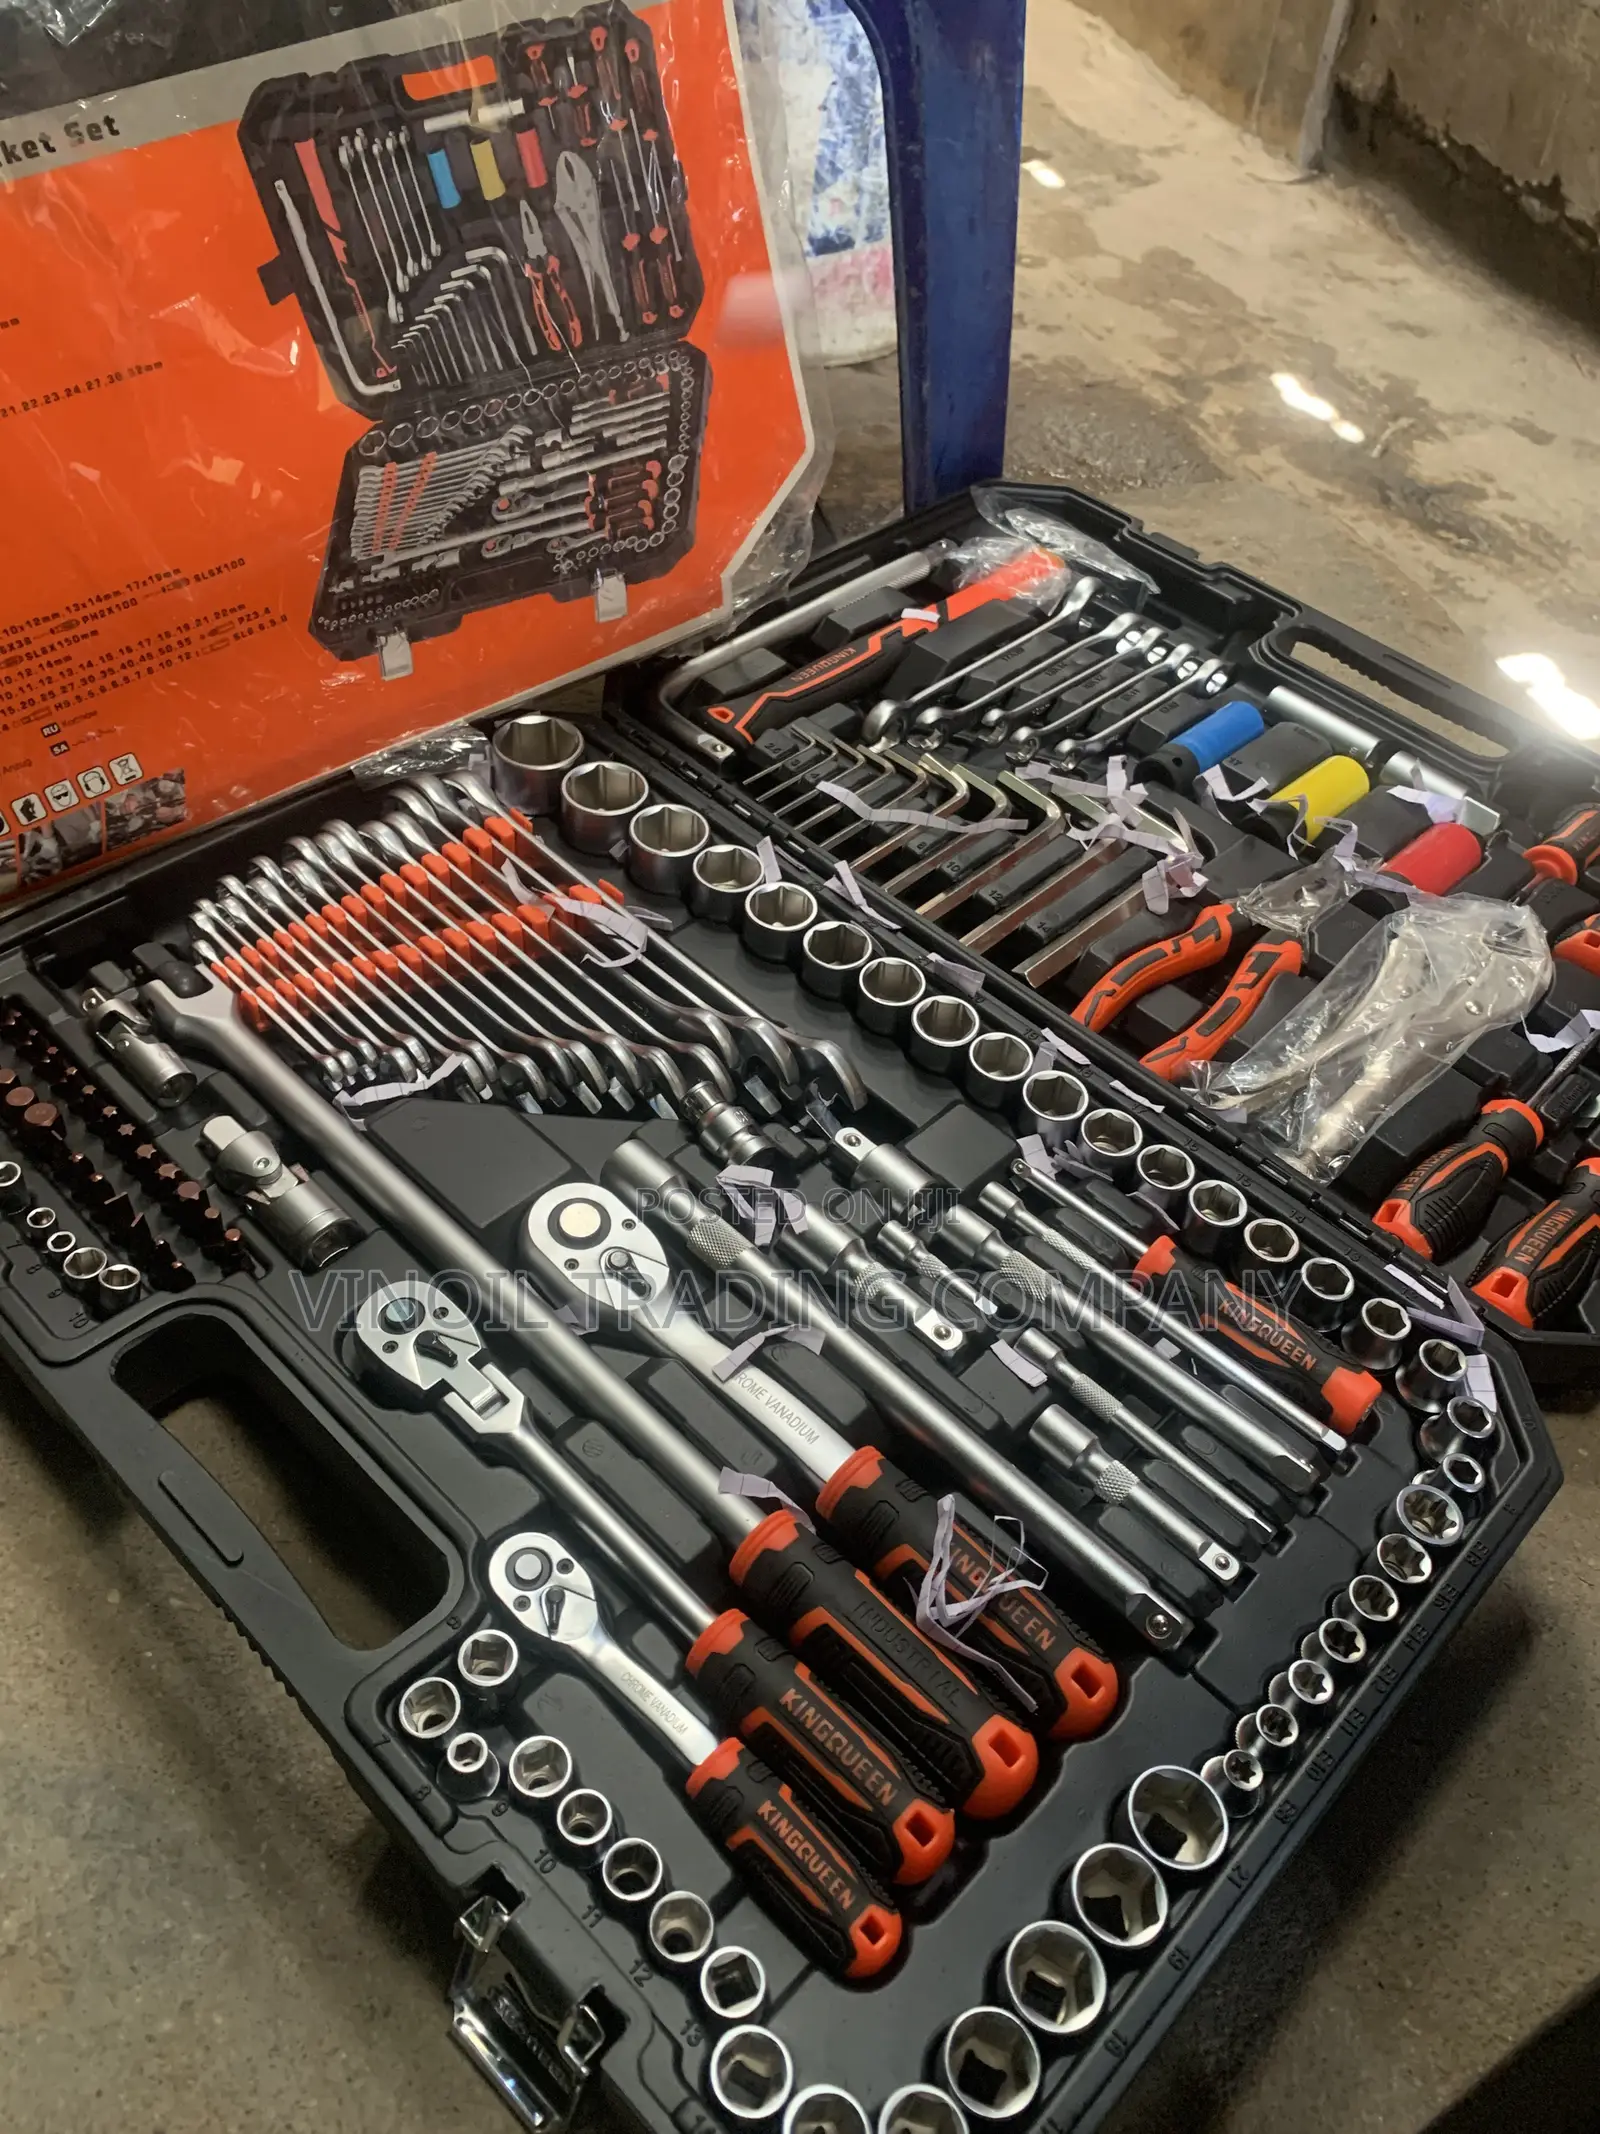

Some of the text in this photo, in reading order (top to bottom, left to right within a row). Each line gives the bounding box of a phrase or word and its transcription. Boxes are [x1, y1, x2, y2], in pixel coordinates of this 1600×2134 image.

[0, 115, 120, 168] ket Set
[791, 647, 857, 682] KINGQUEEN
[946, 861, 961, 873] 10
[988, 889, 1003, 901] 12
[1236, 1172, 1252, 1187] 15
[1514, 1206, 1578, 1266] KINGQUEEN
[69, 1311, 89, 1329] 10
[1219, 1300, 1318, 1371] KINGQUEEN
[736, 1371, 820, 1445] ROME VANADIUM
[950, 1543, 1056, 1651] INGUEEN
[852, 1600, 960, 1708] INDUSTRIAL
[1371, 1664, 1399, 1694] E12
[621, 1671, 689, 1736] CHROME VANADIUM
[1340, 1708, 1367, 1737] E11
[779, 1687, 898, 1806] KINGQUEEN
[1305, 1751, 1336, 1782] E10
[534, 1849, 556, 1874] 10
[757, 1800, 856, 1910] KINGQUEEN
[1227, 1865, 1249, 1889] 21
[582, 1904, 603, 1928] 11
[629, 1958, 653, 1988] 12
[1167, 1946, 1190, 1971] 19
[680, 2019, 704, 2048] 13
[1103, 2028, 1128, 2058] 18
